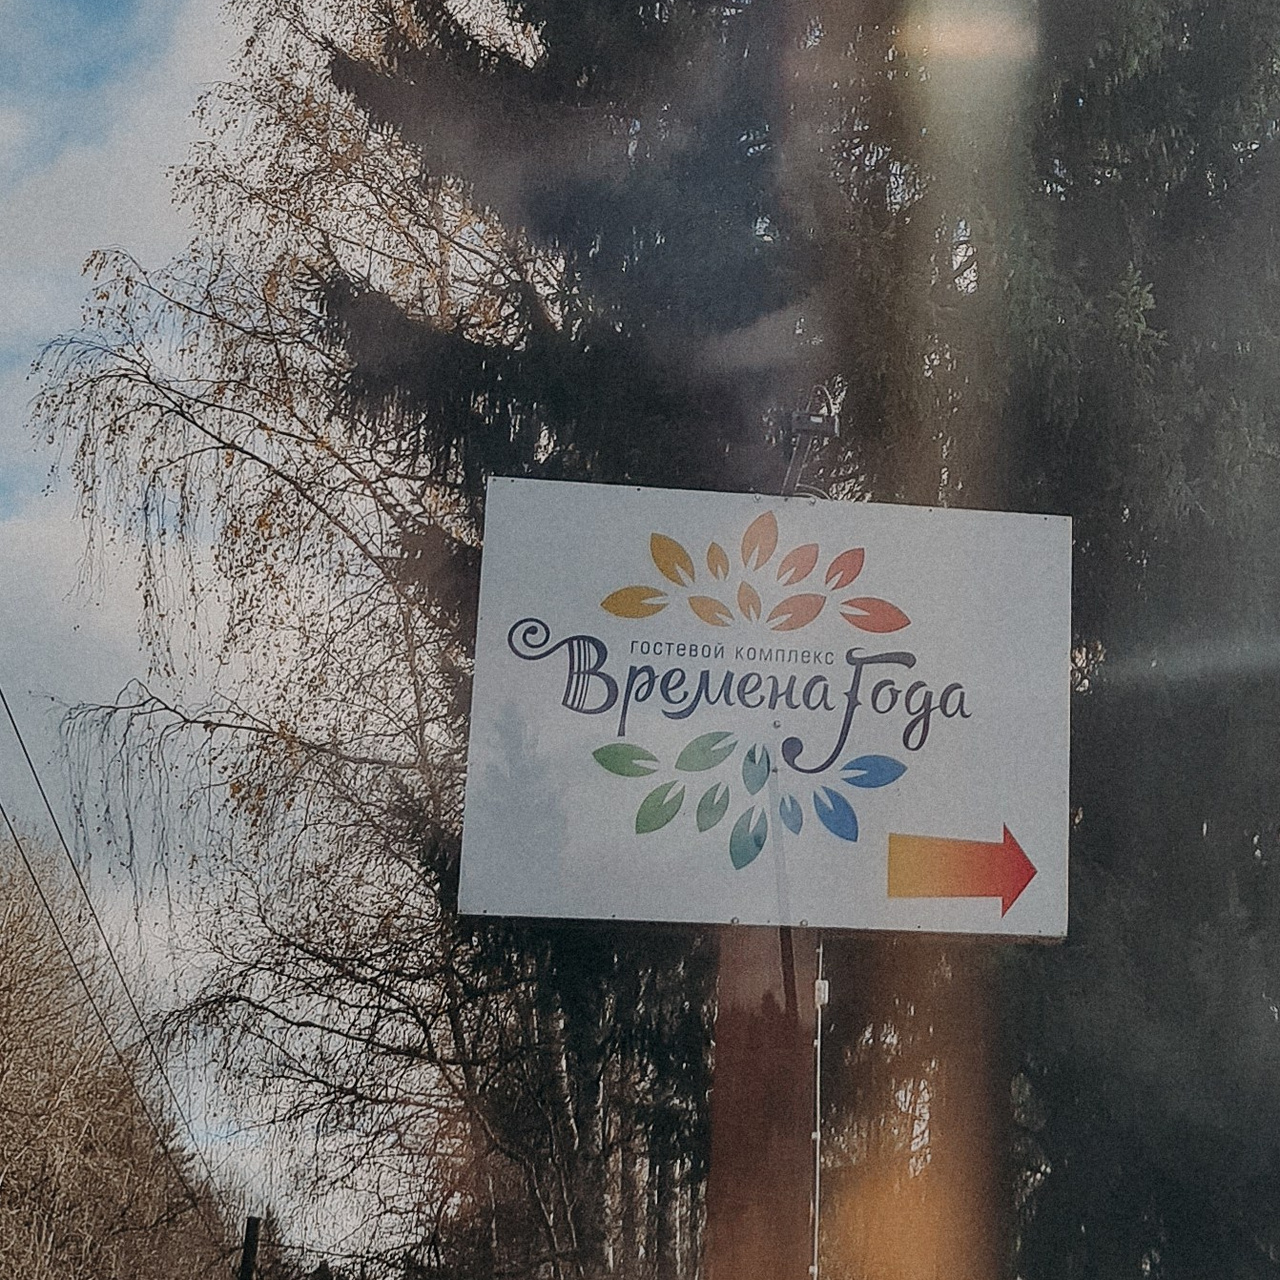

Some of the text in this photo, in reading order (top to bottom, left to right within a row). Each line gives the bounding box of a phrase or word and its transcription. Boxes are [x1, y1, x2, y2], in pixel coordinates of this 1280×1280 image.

[507, 617, 973, 774] Времена Года
[629, 639, 835, 666] гостевой комплекс
